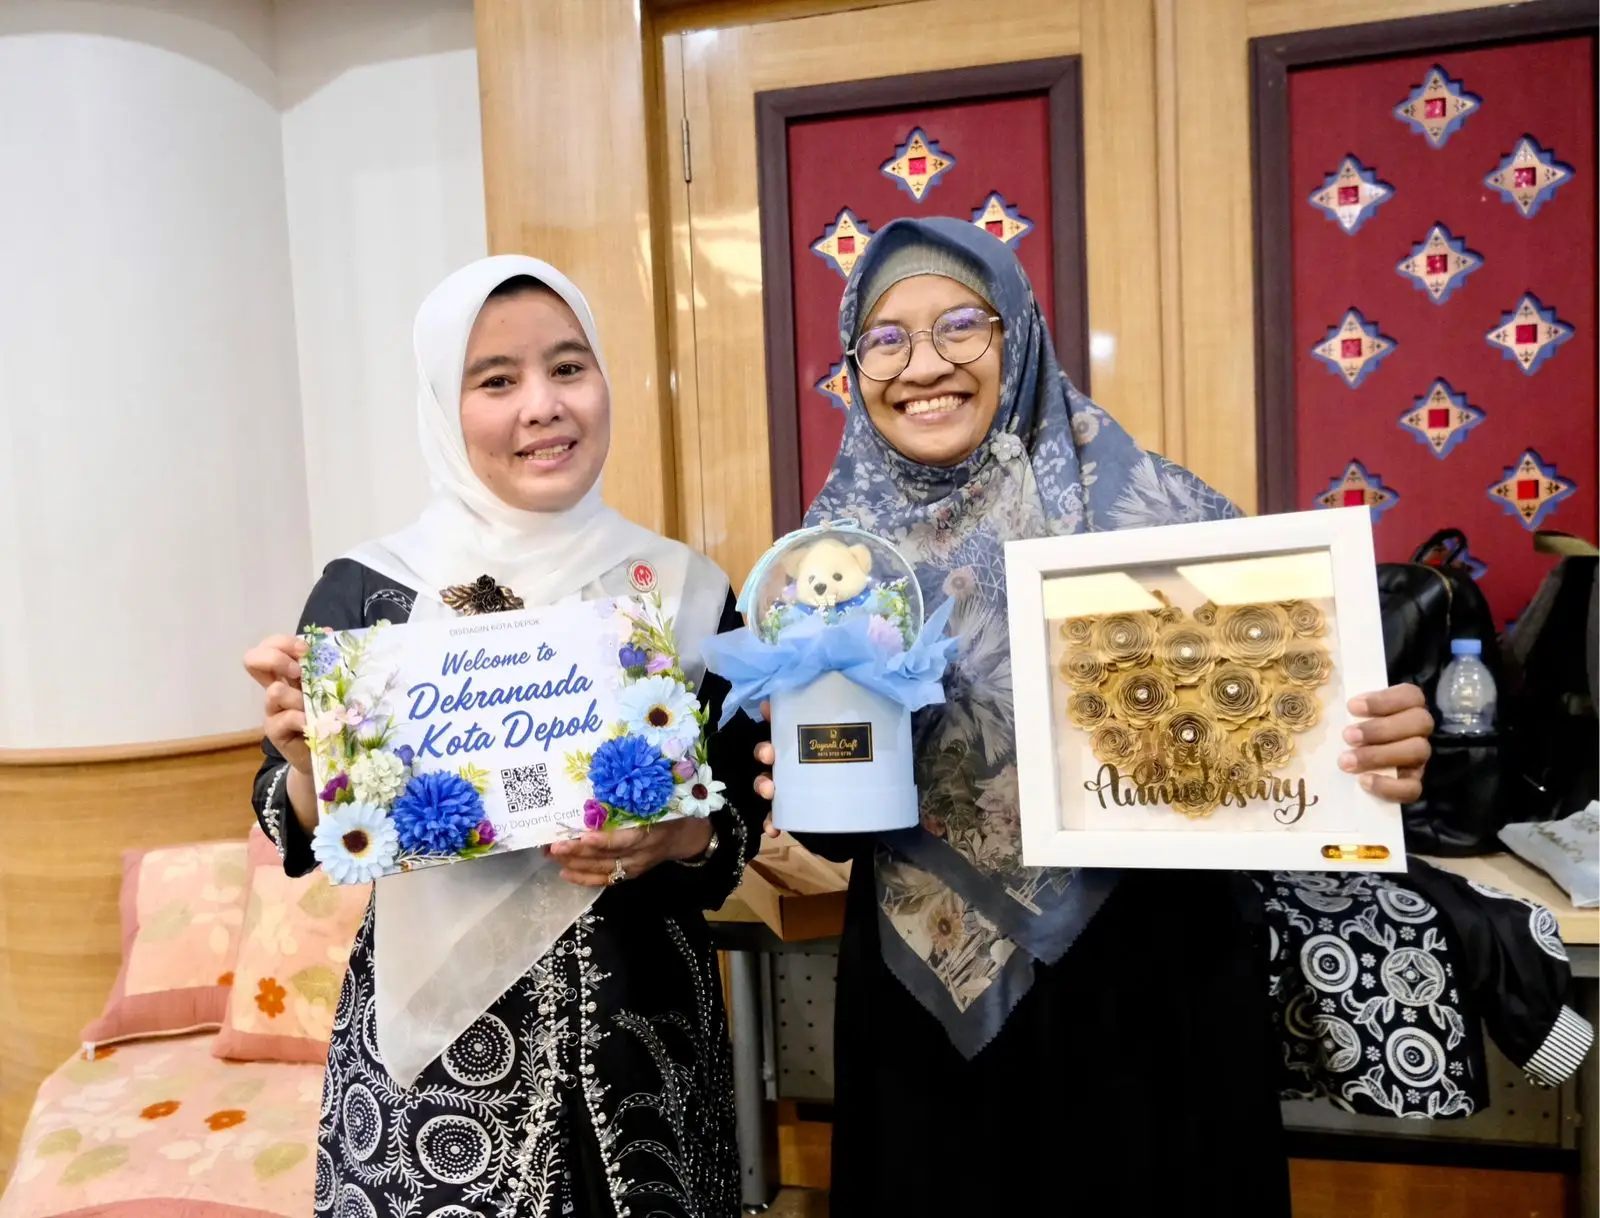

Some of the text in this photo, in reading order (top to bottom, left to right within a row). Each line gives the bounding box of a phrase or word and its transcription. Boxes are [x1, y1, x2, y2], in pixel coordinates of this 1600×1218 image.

[490, 621, 513, 631] KOTA
[514, 619, 541, 629] DEPOK
[441, 642, 557, 676] Welcome to
[407, 663, 593, 720] Dekranasda
[417, 698, 603, 758] Kota Depok
[494, 808, 581, 833] by Dayanti Craft
